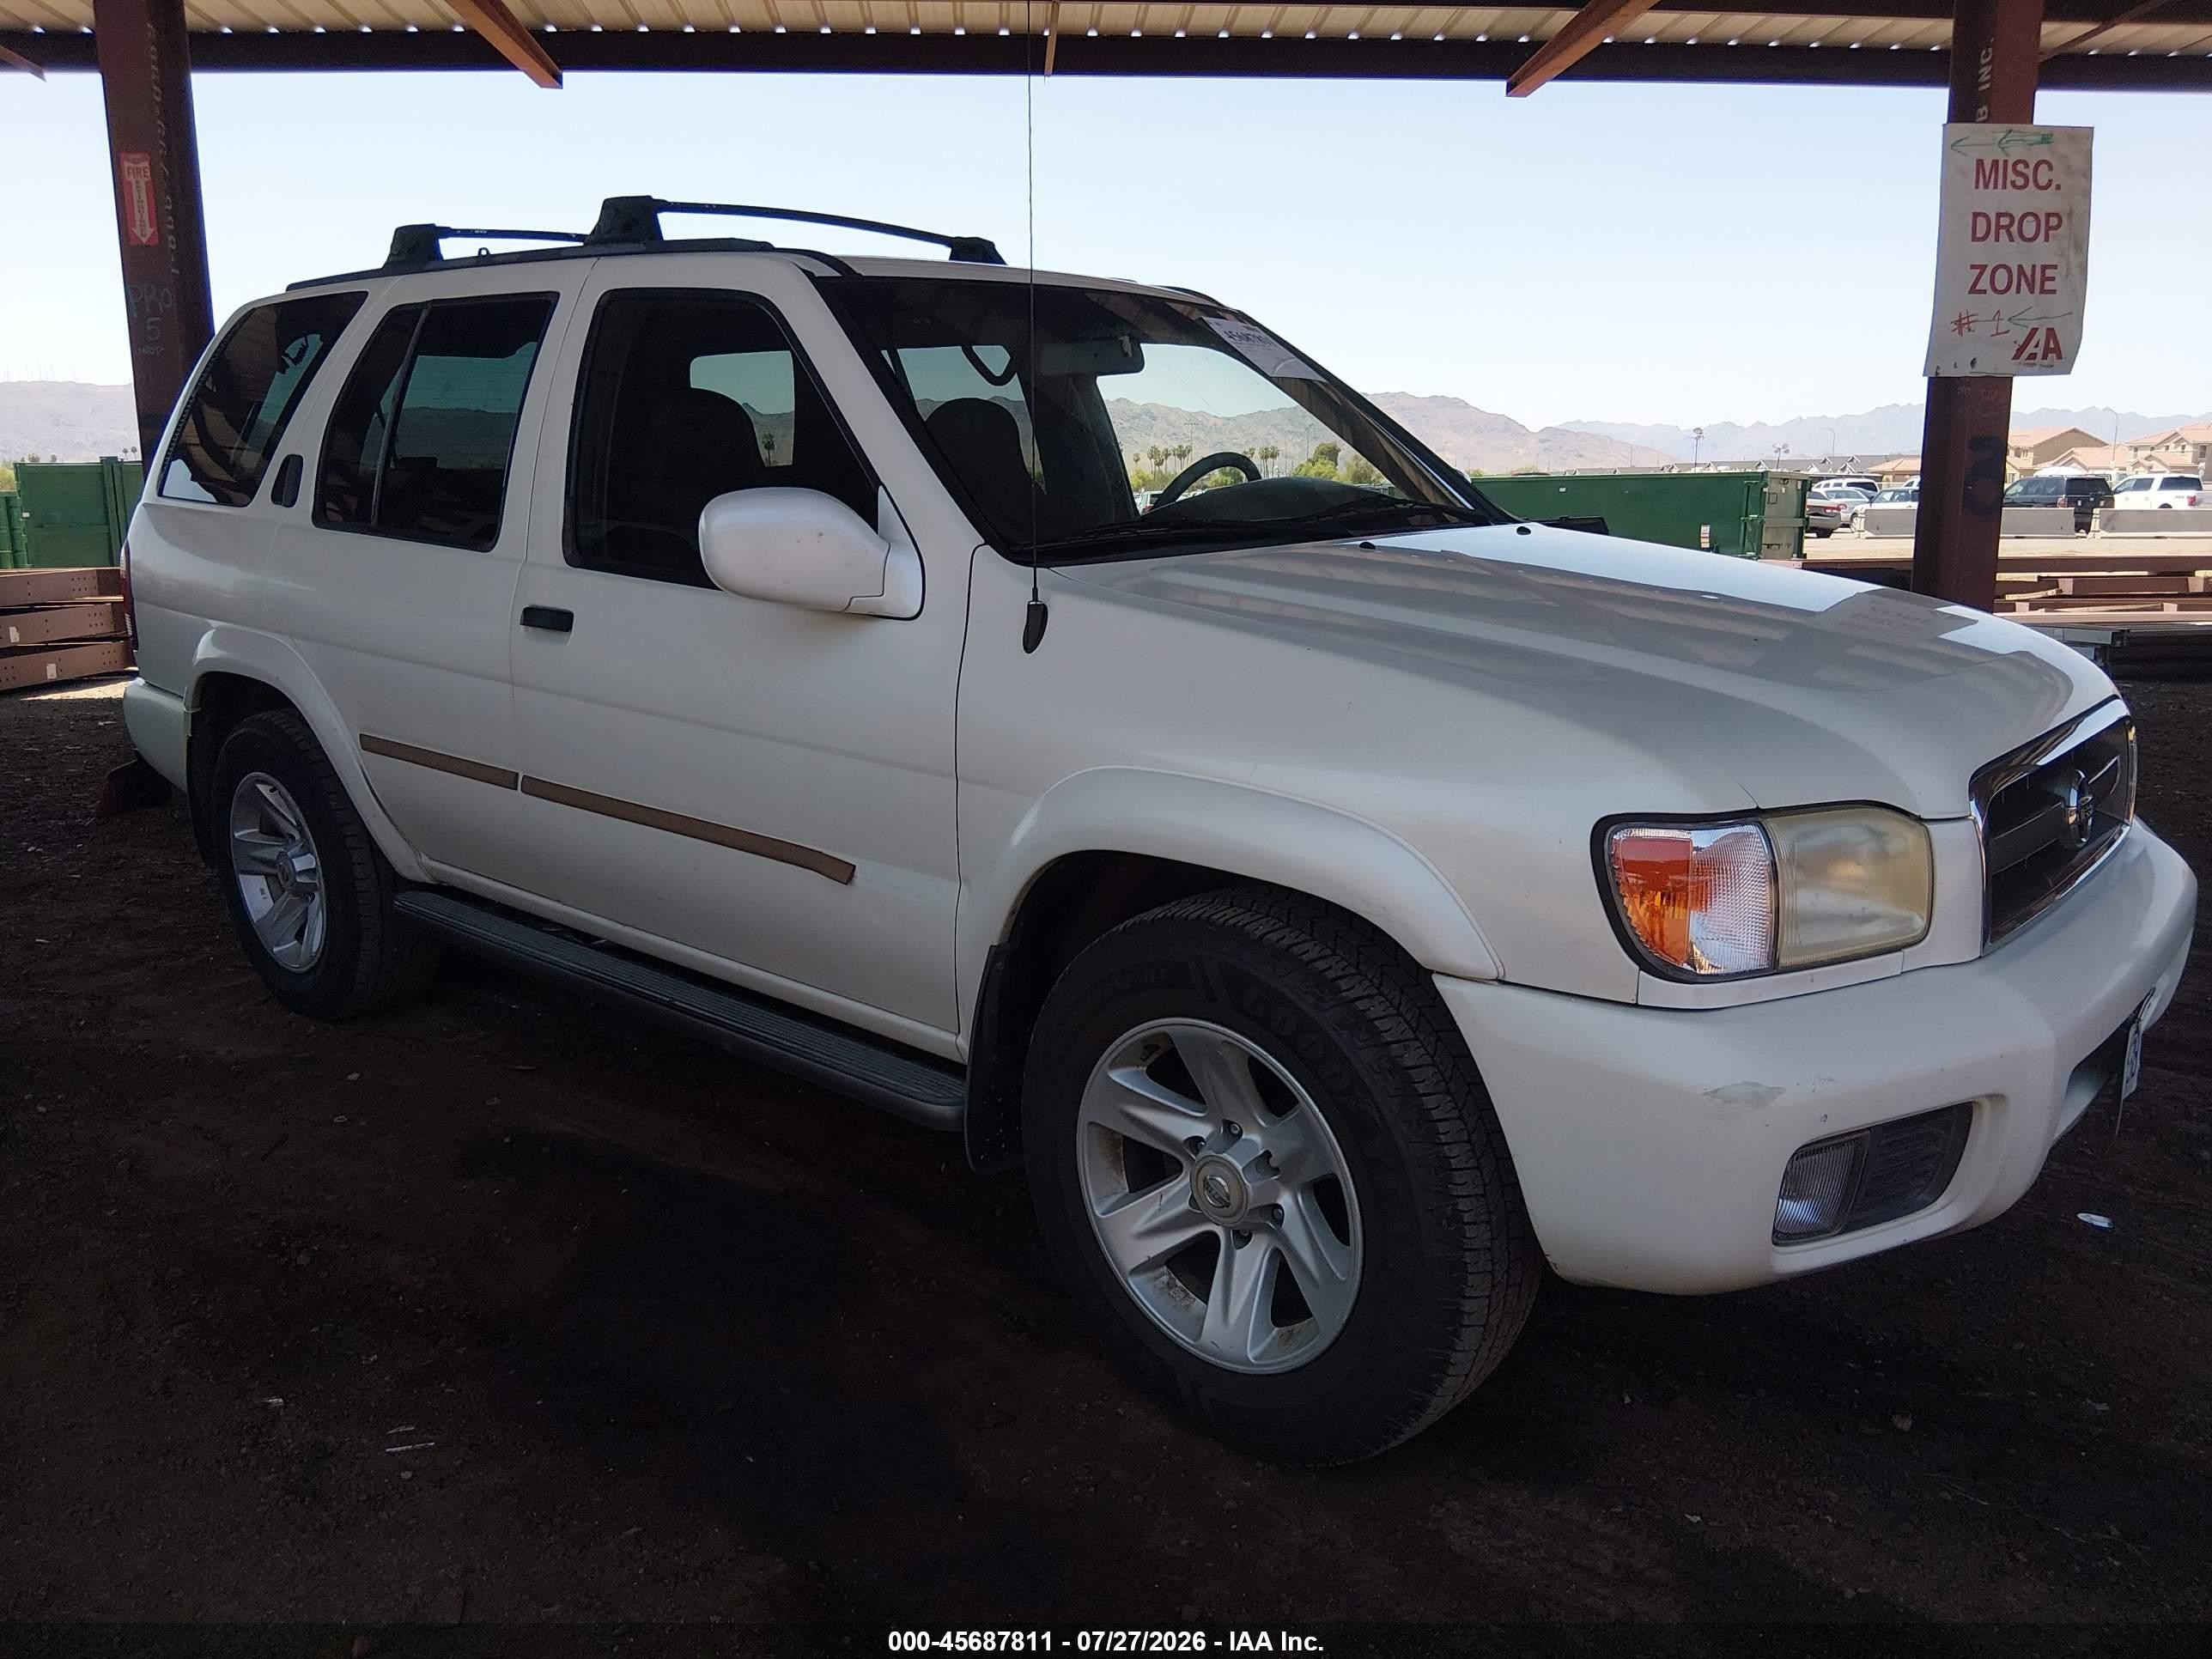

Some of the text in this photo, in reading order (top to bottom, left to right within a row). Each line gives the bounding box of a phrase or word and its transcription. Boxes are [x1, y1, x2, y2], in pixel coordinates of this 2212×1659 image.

[1979, 37, 1994, 92] INC.
[126, 166, 149, 179] FIRE
[1974, 159, 2062, 191] MISC.
[1971, 211, 2063, 243] DROP
[1967, 264, 2058, 296] ZONE
